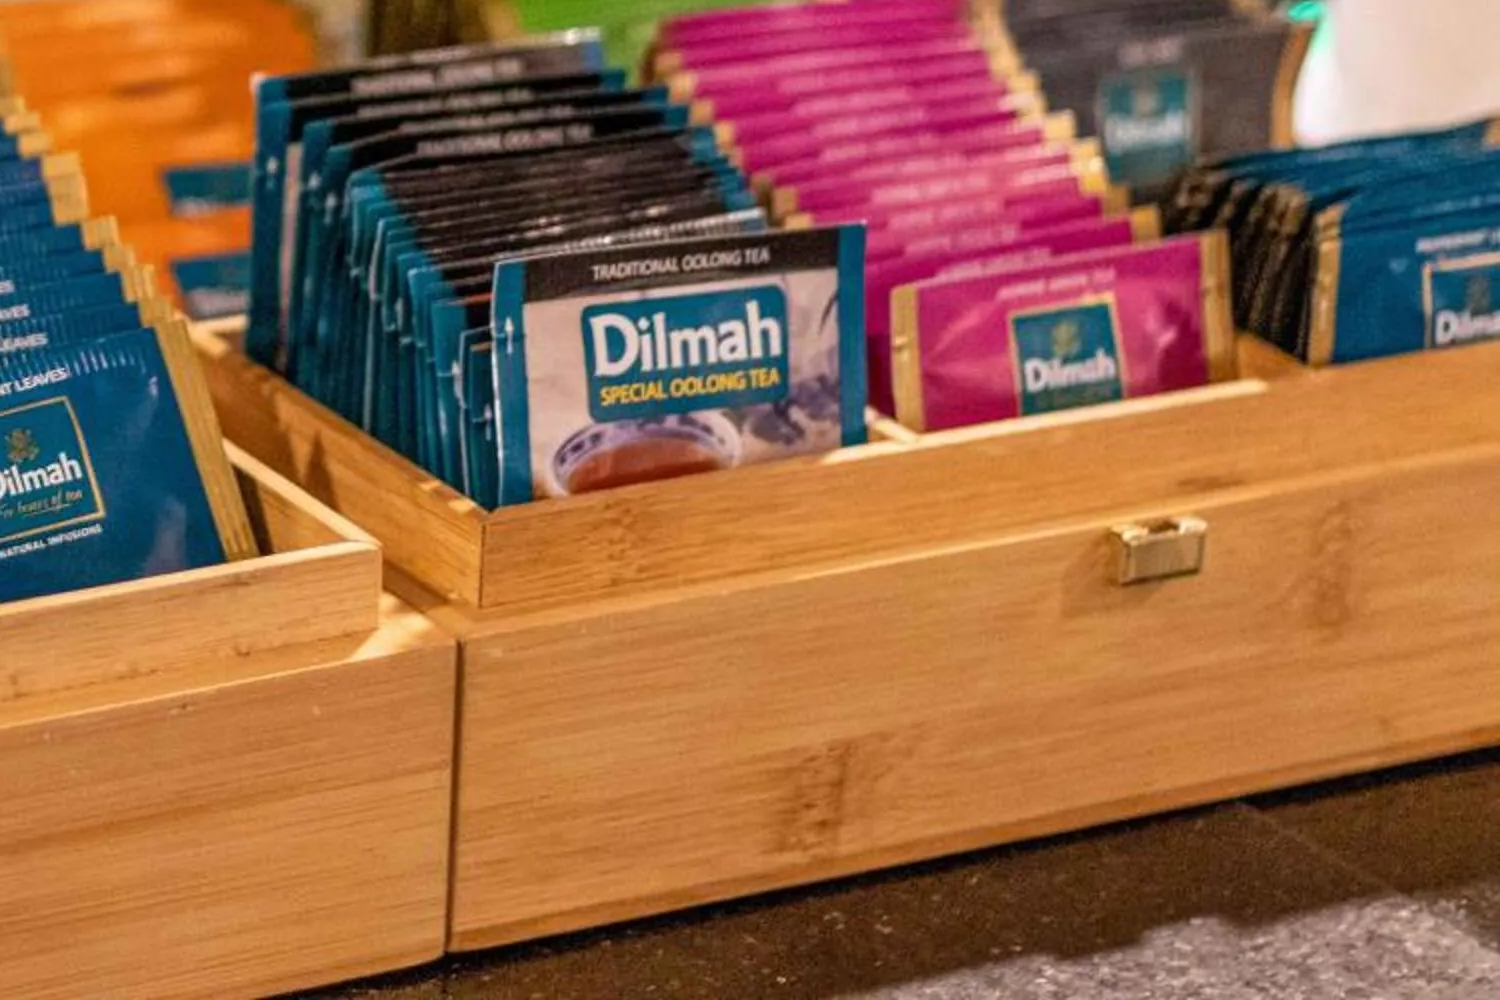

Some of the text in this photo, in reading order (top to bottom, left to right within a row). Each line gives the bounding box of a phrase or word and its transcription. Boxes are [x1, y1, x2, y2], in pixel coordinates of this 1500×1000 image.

[591, 245, 771, 281] TRADITIONAL OOLONG TEA
[589, 299, 783, 377] Dilmah
[14, 366, 70, 392] LEAVES
[600, 366, 781, 407] SPECIAL OOLONG TEA
[1024, 347, 1117, 394] Dilmah
[47, 522, 103, 547] INFUSIONS
